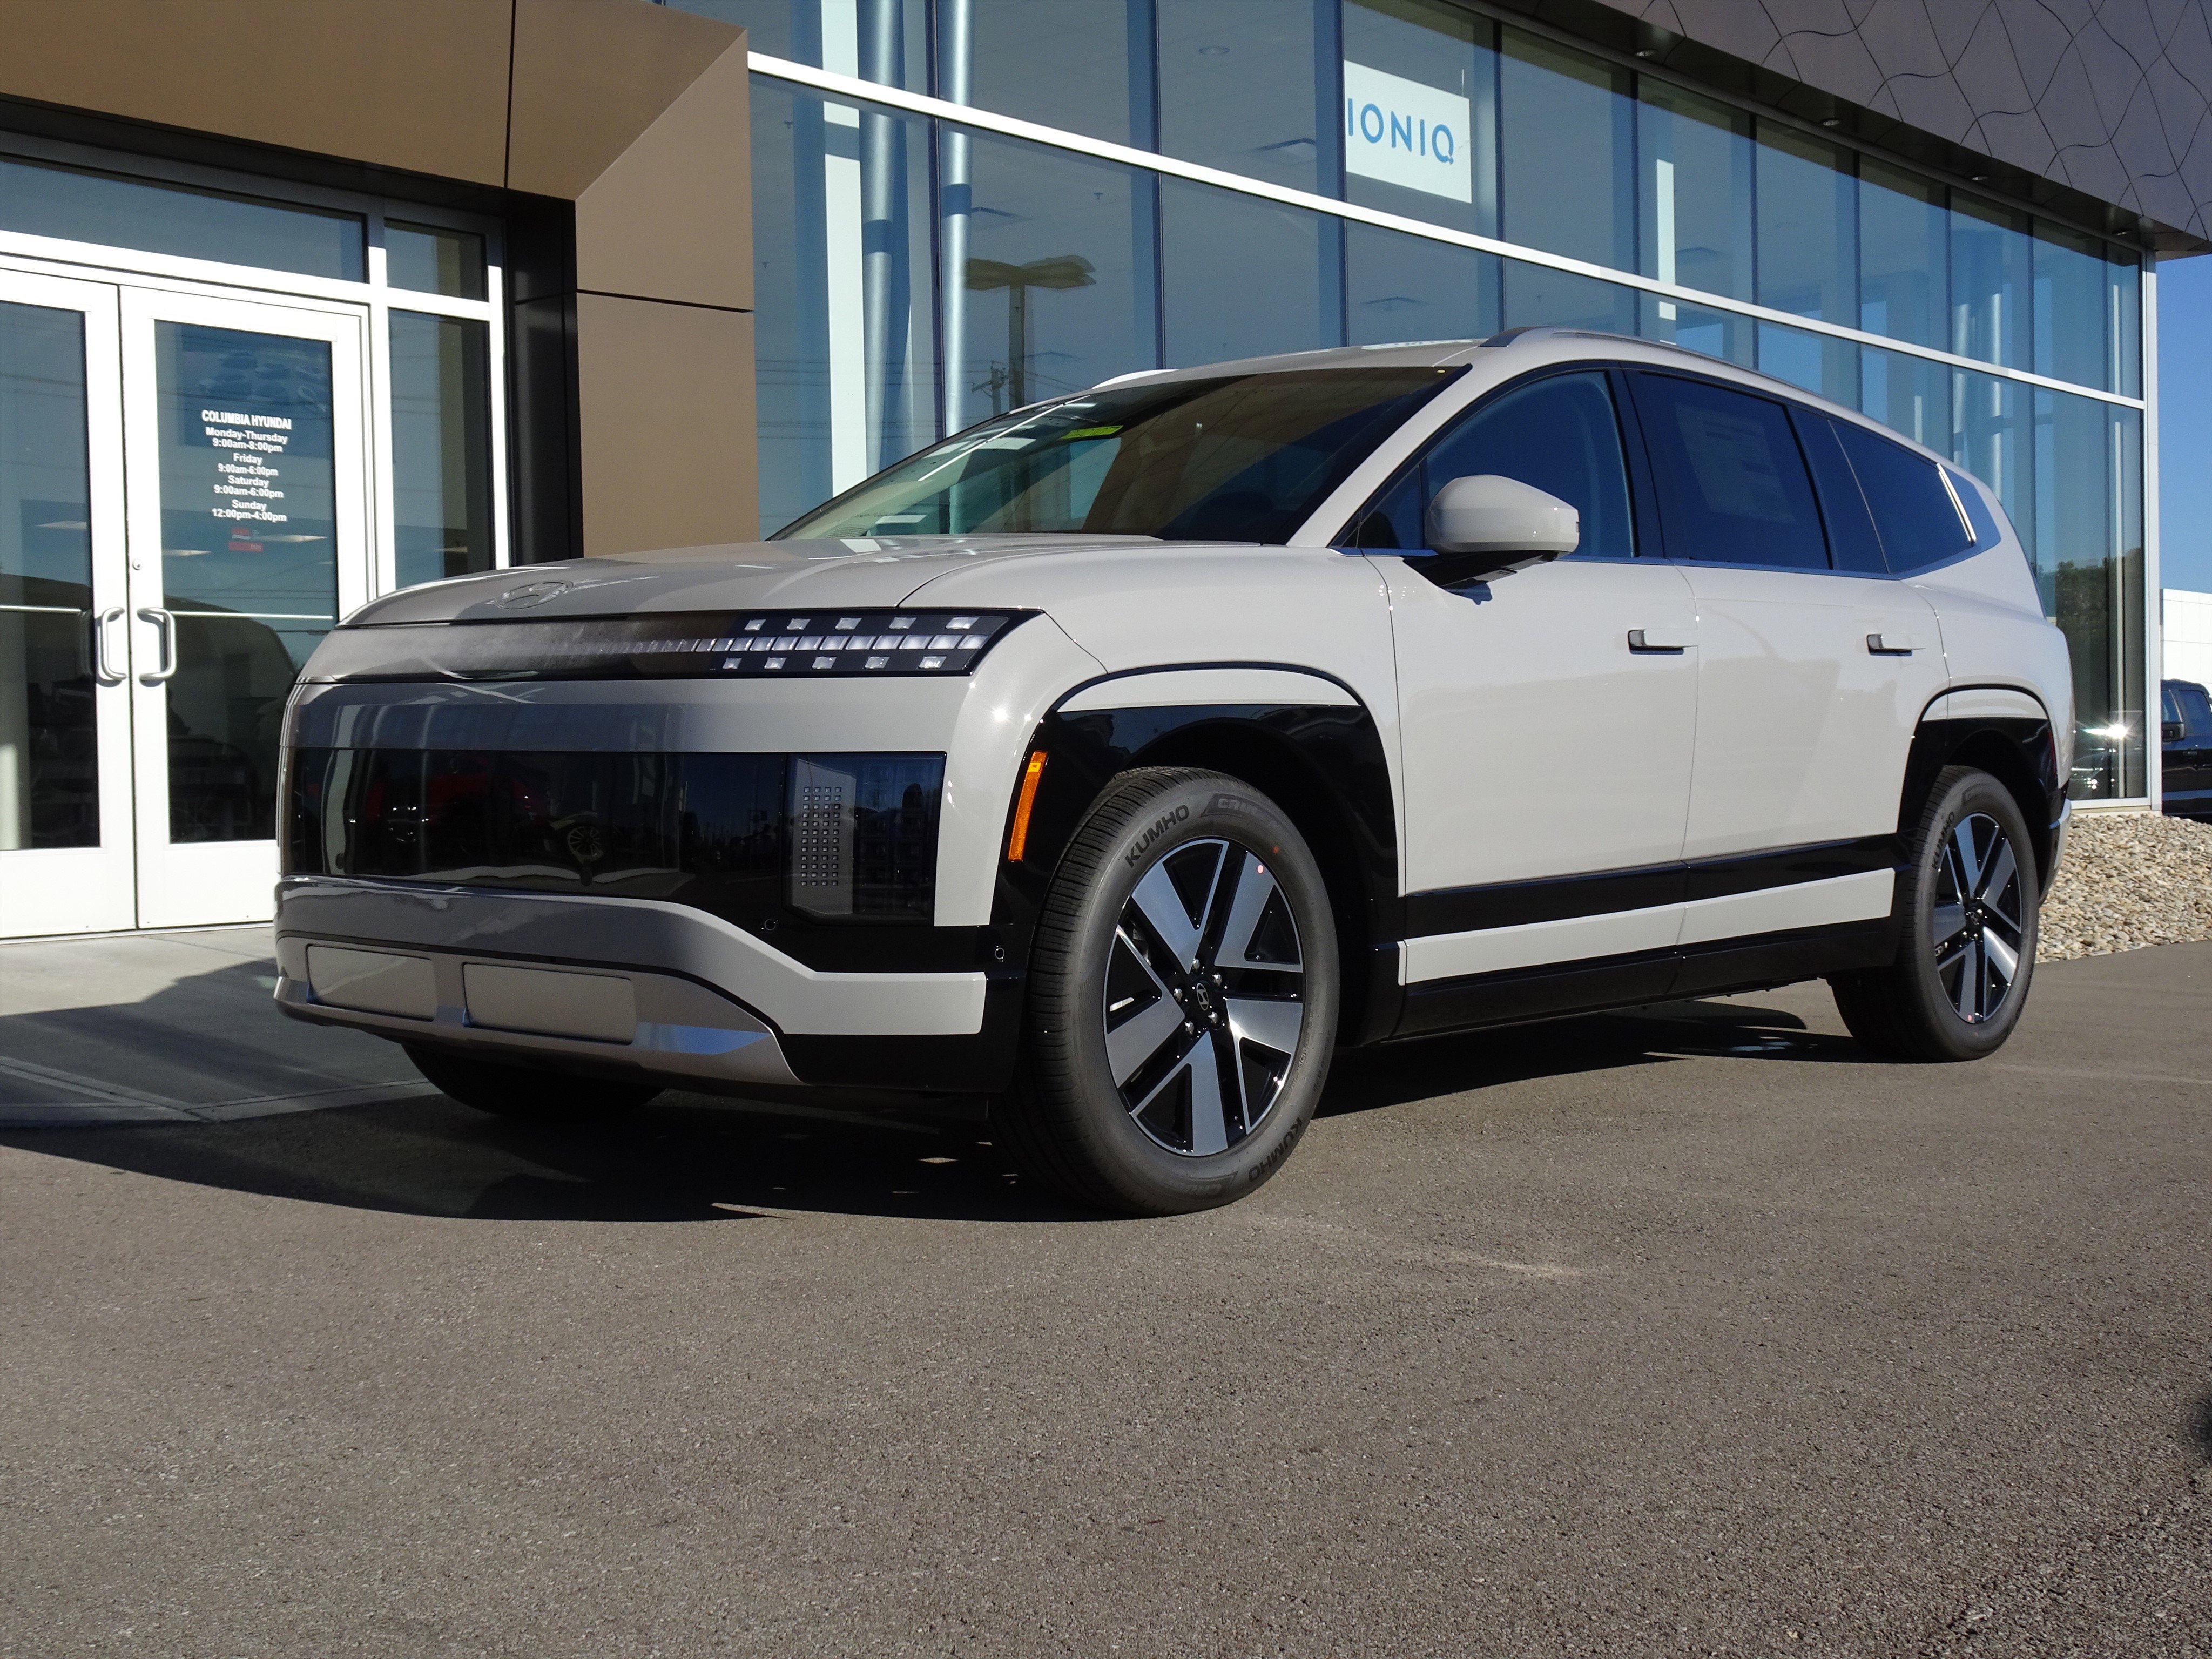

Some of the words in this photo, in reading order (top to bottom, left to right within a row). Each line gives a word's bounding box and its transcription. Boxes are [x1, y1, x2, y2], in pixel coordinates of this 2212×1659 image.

[1347, 98, 1454, 165] IONIQ
[202, 410, 251, 426] COLUMBIA
[251, 415, 292, 429] HYUNDAI
[205, 427, 288, 445] Monday-Thursday
[213, 438, 283, 453] 9:00am-8:00pm
[233, 453, 262, 465] Friday
[218, 463, 279, 477] 9:00am-6:00pm
[228, 475, 269, 488] Saturday
[213, 484, 284, 499] 9:00am-6:00pm
[232, 499, 267, 511] Sunday
[212, 508, 287, 523] 12:00pm-4:00pm
[1124, 804, 1189, 867] KUMHO
[1248, 1117, 1303, 1182] KUMHO
